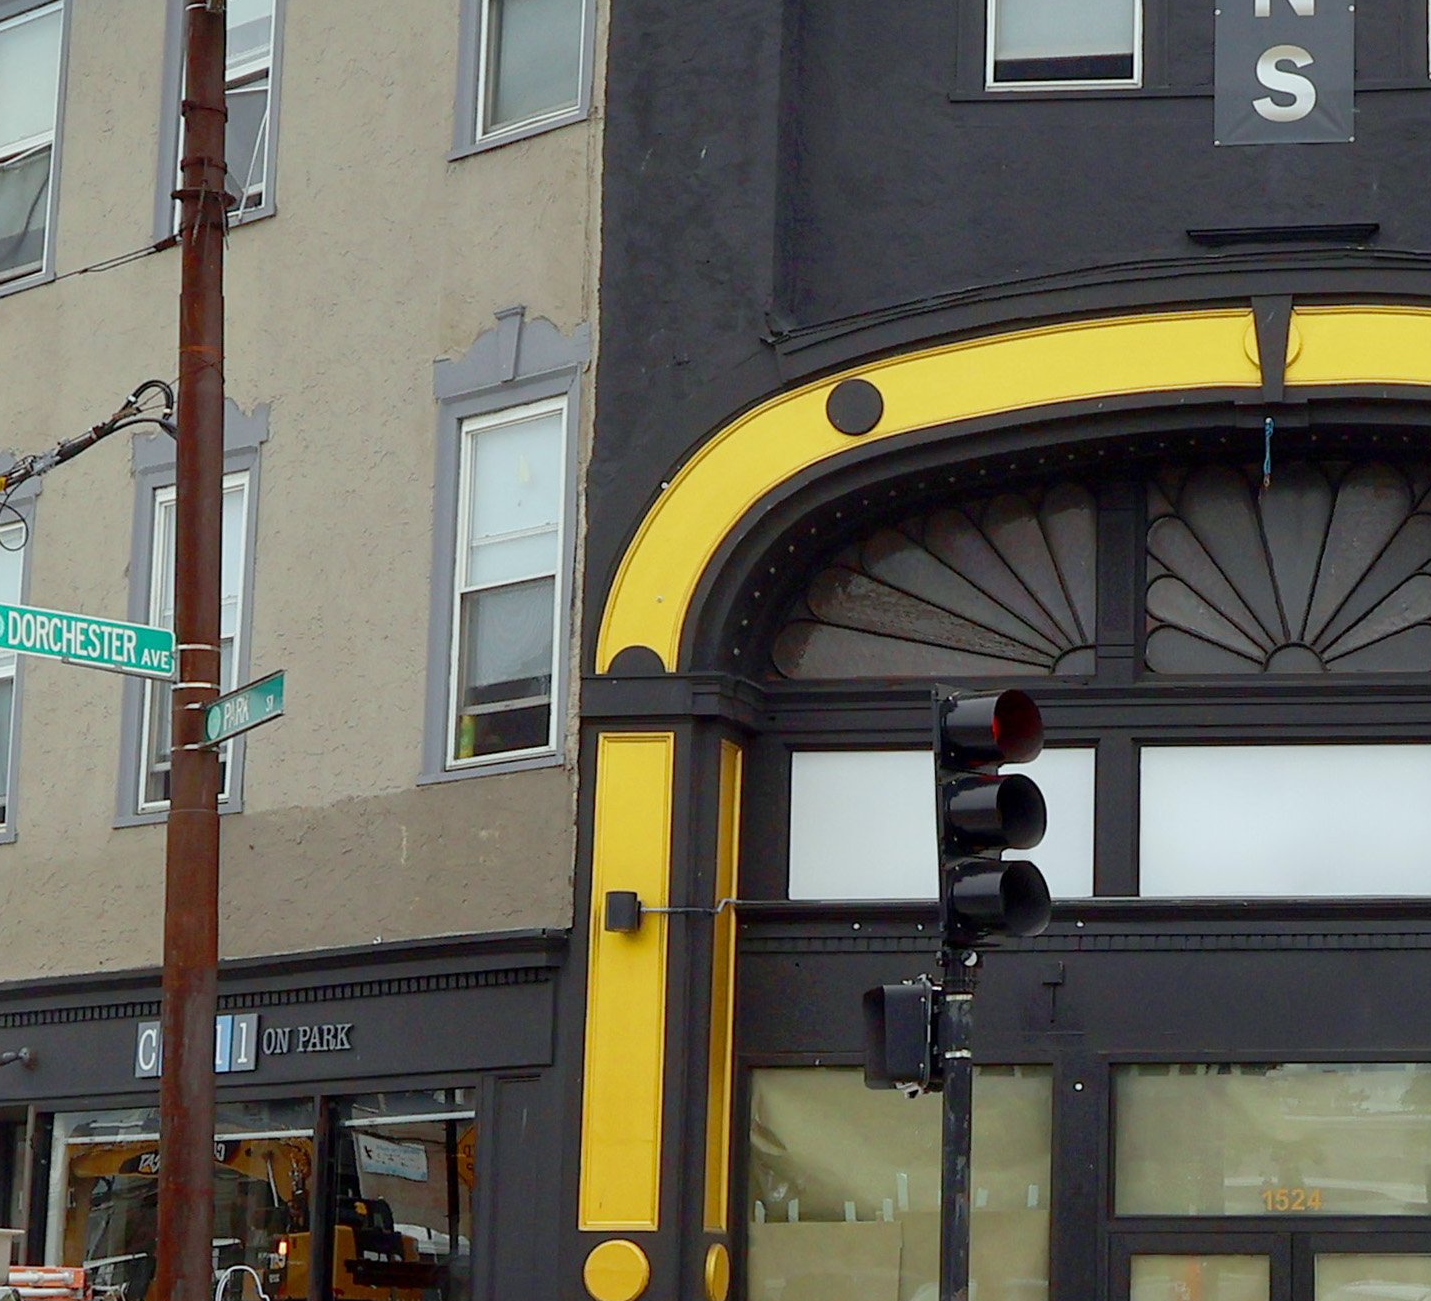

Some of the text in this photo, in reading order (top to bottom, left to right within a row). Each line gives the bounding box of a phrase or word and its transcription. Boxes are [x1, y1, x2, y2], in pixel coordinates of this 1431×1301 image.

[7, 611, 170, 669] DORCHESTER AVE
[223, 695, 249, 731] PARK
[138, 1022, 352, 1071] Cll ON PARK
[1261, 1187, 1322, 1211] 1524
